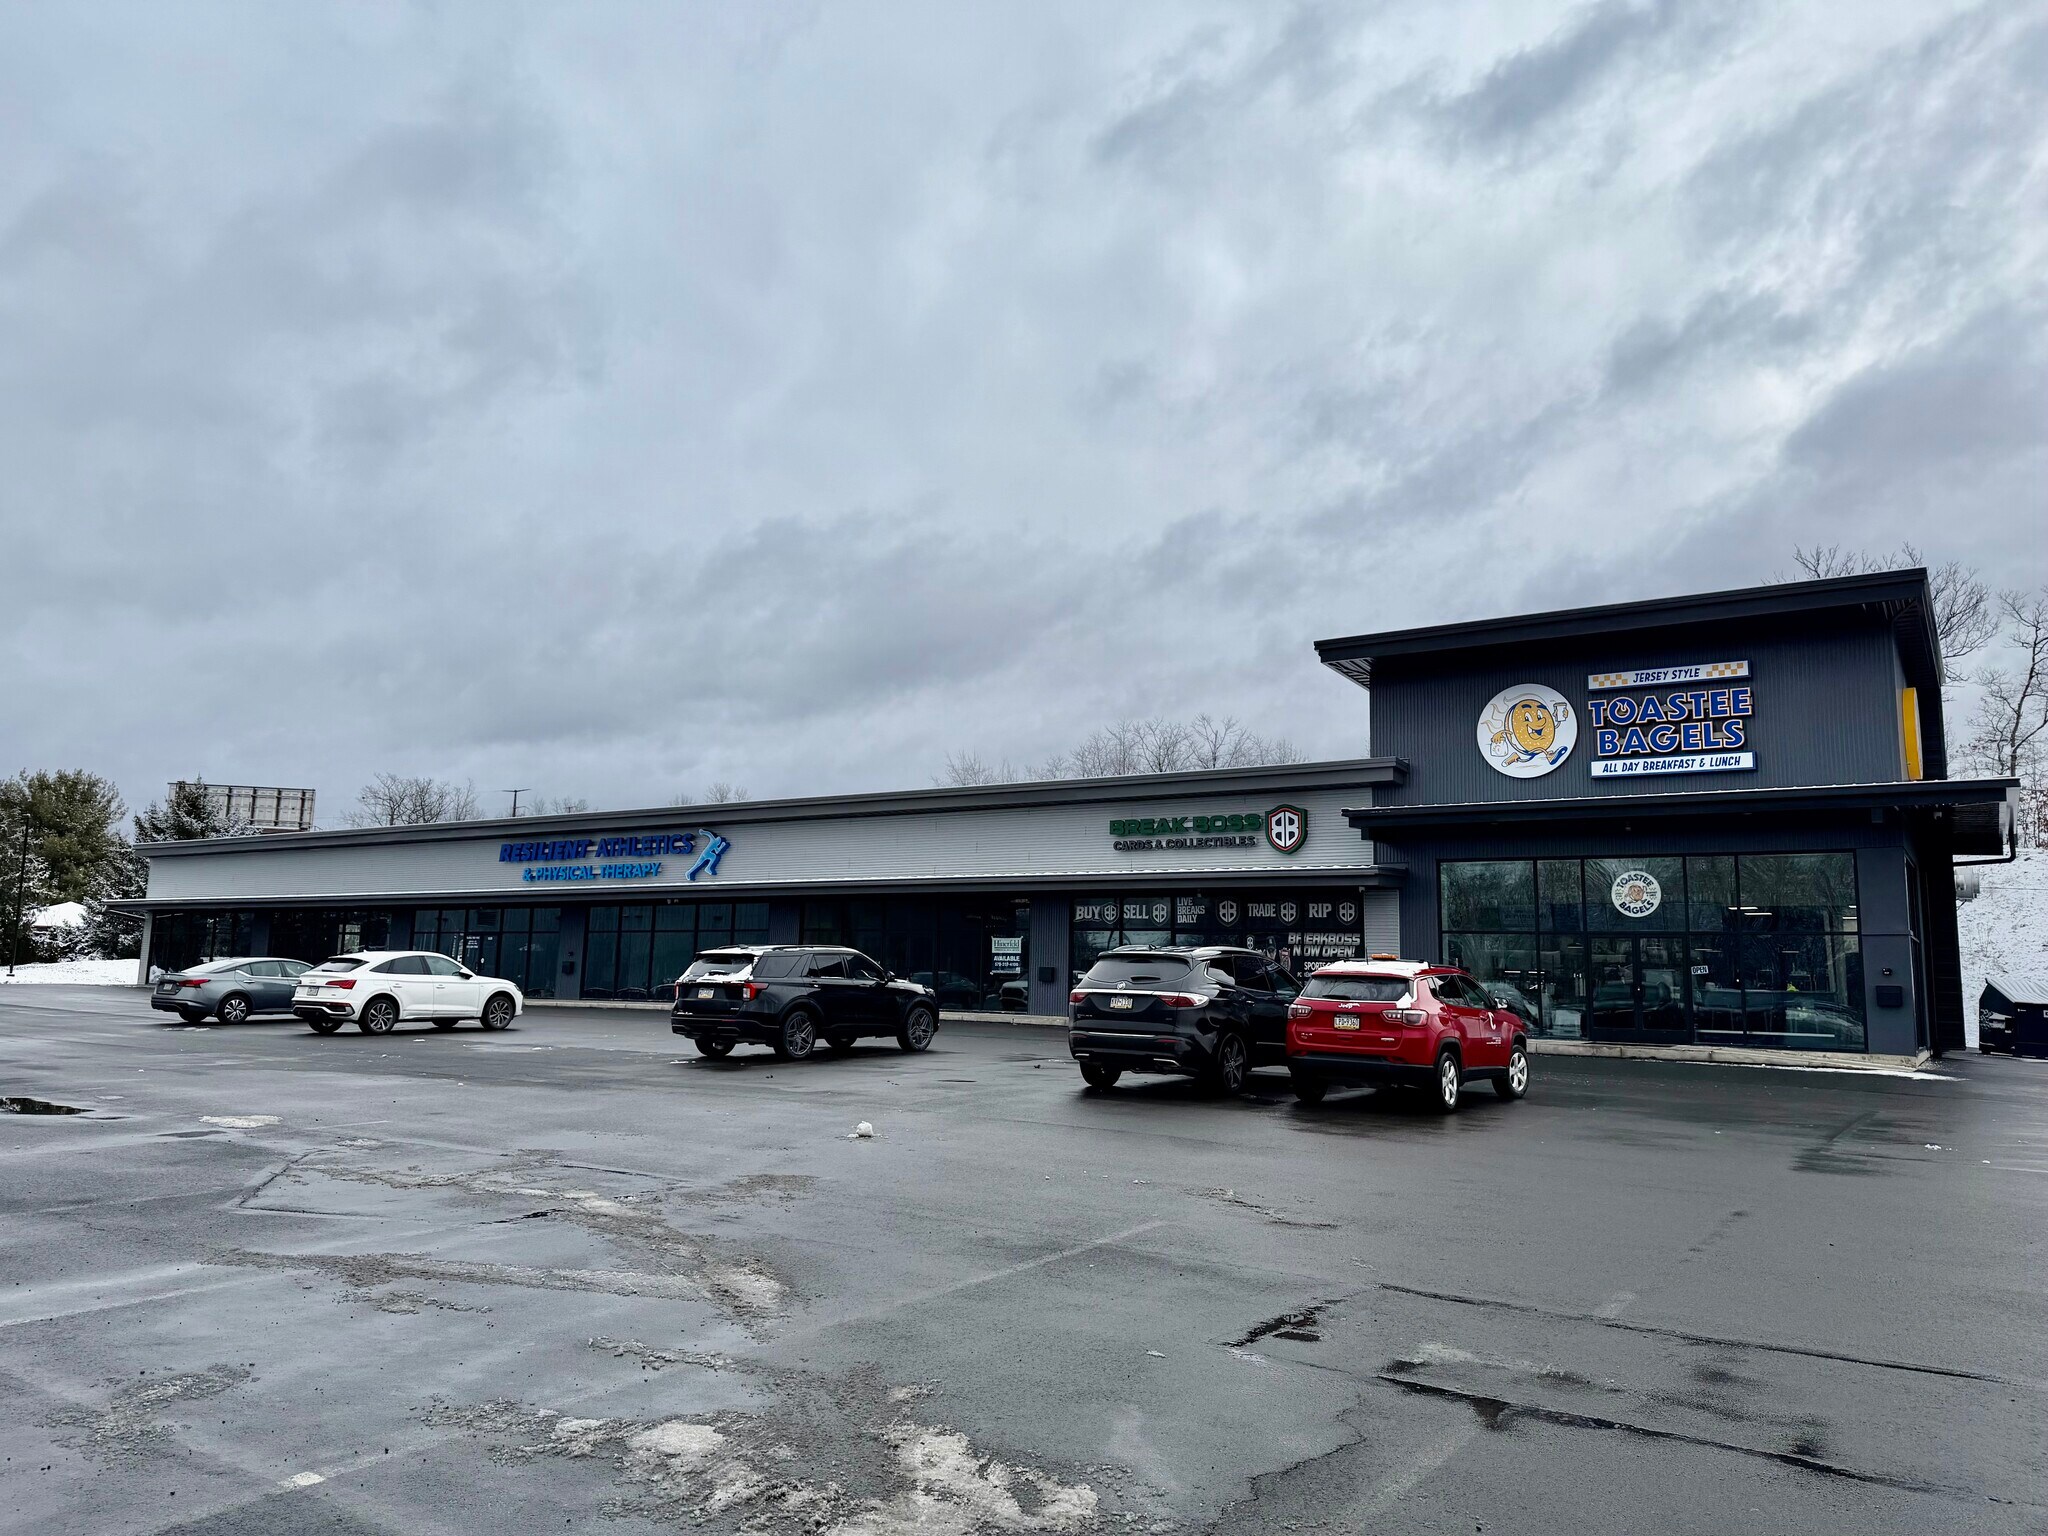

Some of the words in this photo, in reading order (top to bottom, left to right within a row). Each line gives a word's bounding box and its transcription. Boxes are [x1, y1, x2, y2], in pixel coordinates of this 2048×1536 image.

[1633, 670, 1669, 683] JERSEY
[1672, 668, 1701, 680] STYLE
[1588, 687, 1753, 727] TOASTEE
[1597, 719, 1745, 756] BAGELS
[1602, 763, 1618, 774] ALL
[1622, 761, 1640, 772] DAY
[1642, 758, 1697, 771] BREAKFAST
[1699, 757, 1706, 768] &
[1709, 756, 1741, 767] LUNCH
[1109, 816, 1190, 836] BREAK
[1192, 813, 1263, 832] BOSS
[499, 838, 593, 863] RESILIENT
[595, 832, 696, 858] ATHLETICS
[1113, 839, 1153, 851] CARDS
[1155, 839, 1164, 849] &
[1166, 835, 1257, 849] COLLECTIBLES
[522, 867, 533, 882] &
[535, 864, 596, 881] PHYSICAL
[599, 862, 662, 879] THERAPY
[1616, 873, 1654, 888] TOASTEE
[1177, 897, 1193, 906] LIVE
[1619, 900, 1654, 914] BAGELS
[1075, 905, 1101, 921] BUY
[1123, 904, 1149, 919] SELL
[1177, 906, 1205, 915] BREAKS
[1247, 903, 1276, 917] TRADE
[1308, 903, 1332, 918] RIP
[1177, 915, 1198, 923] DAILY
[1293, 945, 1321, 957] NOW
[1322, 945, 1355, 957] OPEN!
[1692, 966, 1707, 974] OPEN
